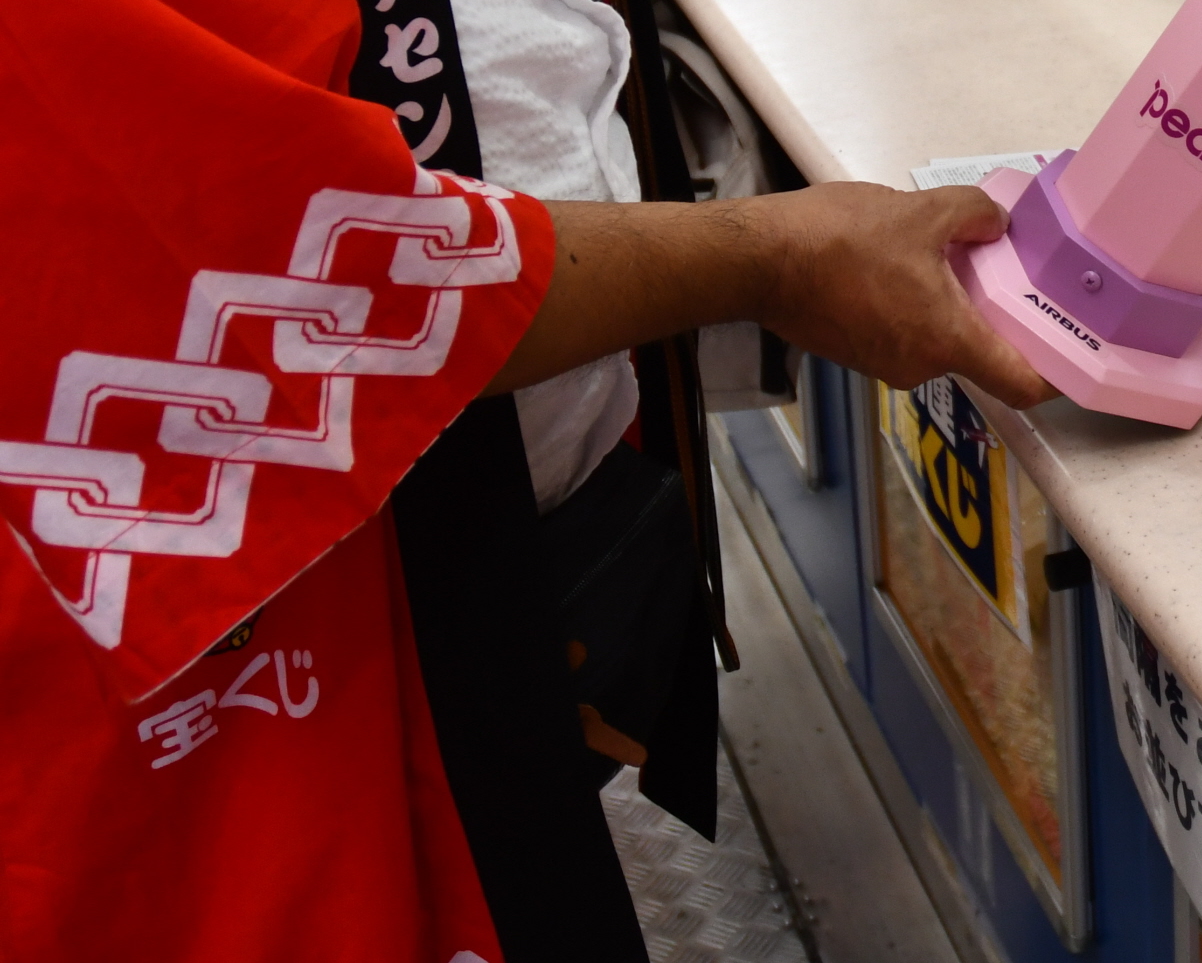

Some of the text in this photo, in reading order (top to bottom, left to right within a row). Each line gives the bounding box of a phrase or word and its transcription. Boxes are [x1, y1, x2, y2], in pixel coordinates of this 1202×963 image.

[1022, 291, 1102, 352] AIRBUS
[138, 649, 320, 770] 宝くじ
